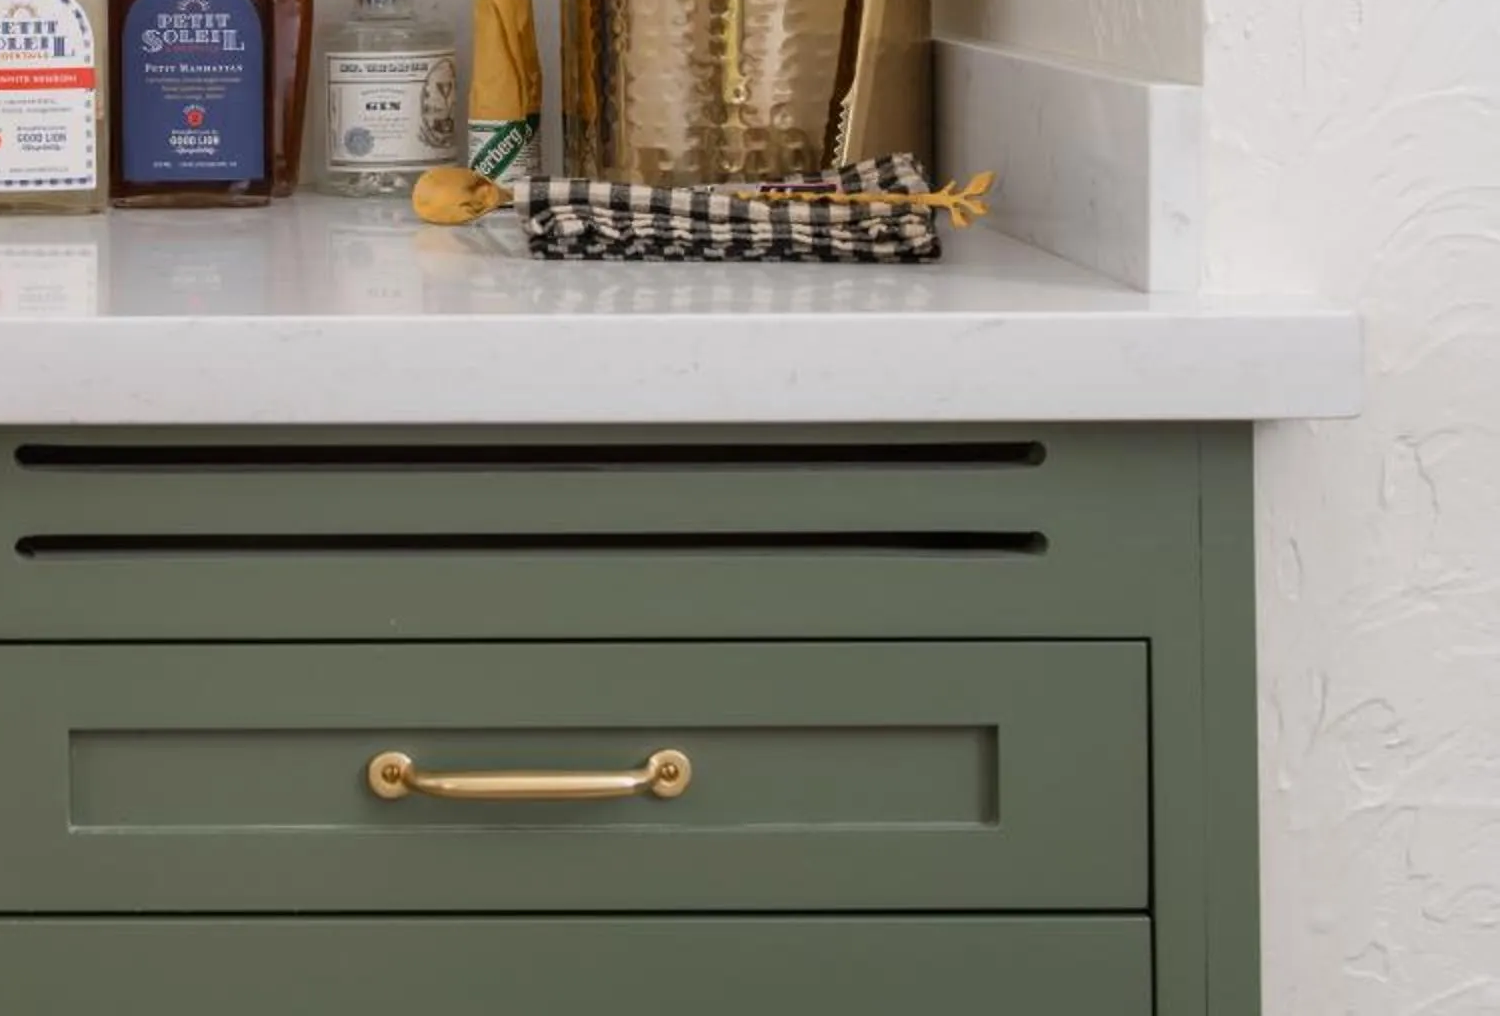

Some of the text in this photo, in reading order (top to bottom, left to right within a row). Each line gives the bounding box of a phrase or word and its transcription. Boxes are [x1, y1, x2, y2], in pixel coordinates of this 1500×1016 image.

[157, 13, 230, 29] PETIT
[142, 30, 245, 53] SOLEIL
[144, 63, 177, 74] PETIT
[365, 100, 401, 112] GIN
[17, 133, 67, 143] GOOD LION
[479, 127, 524, 175] erberg
